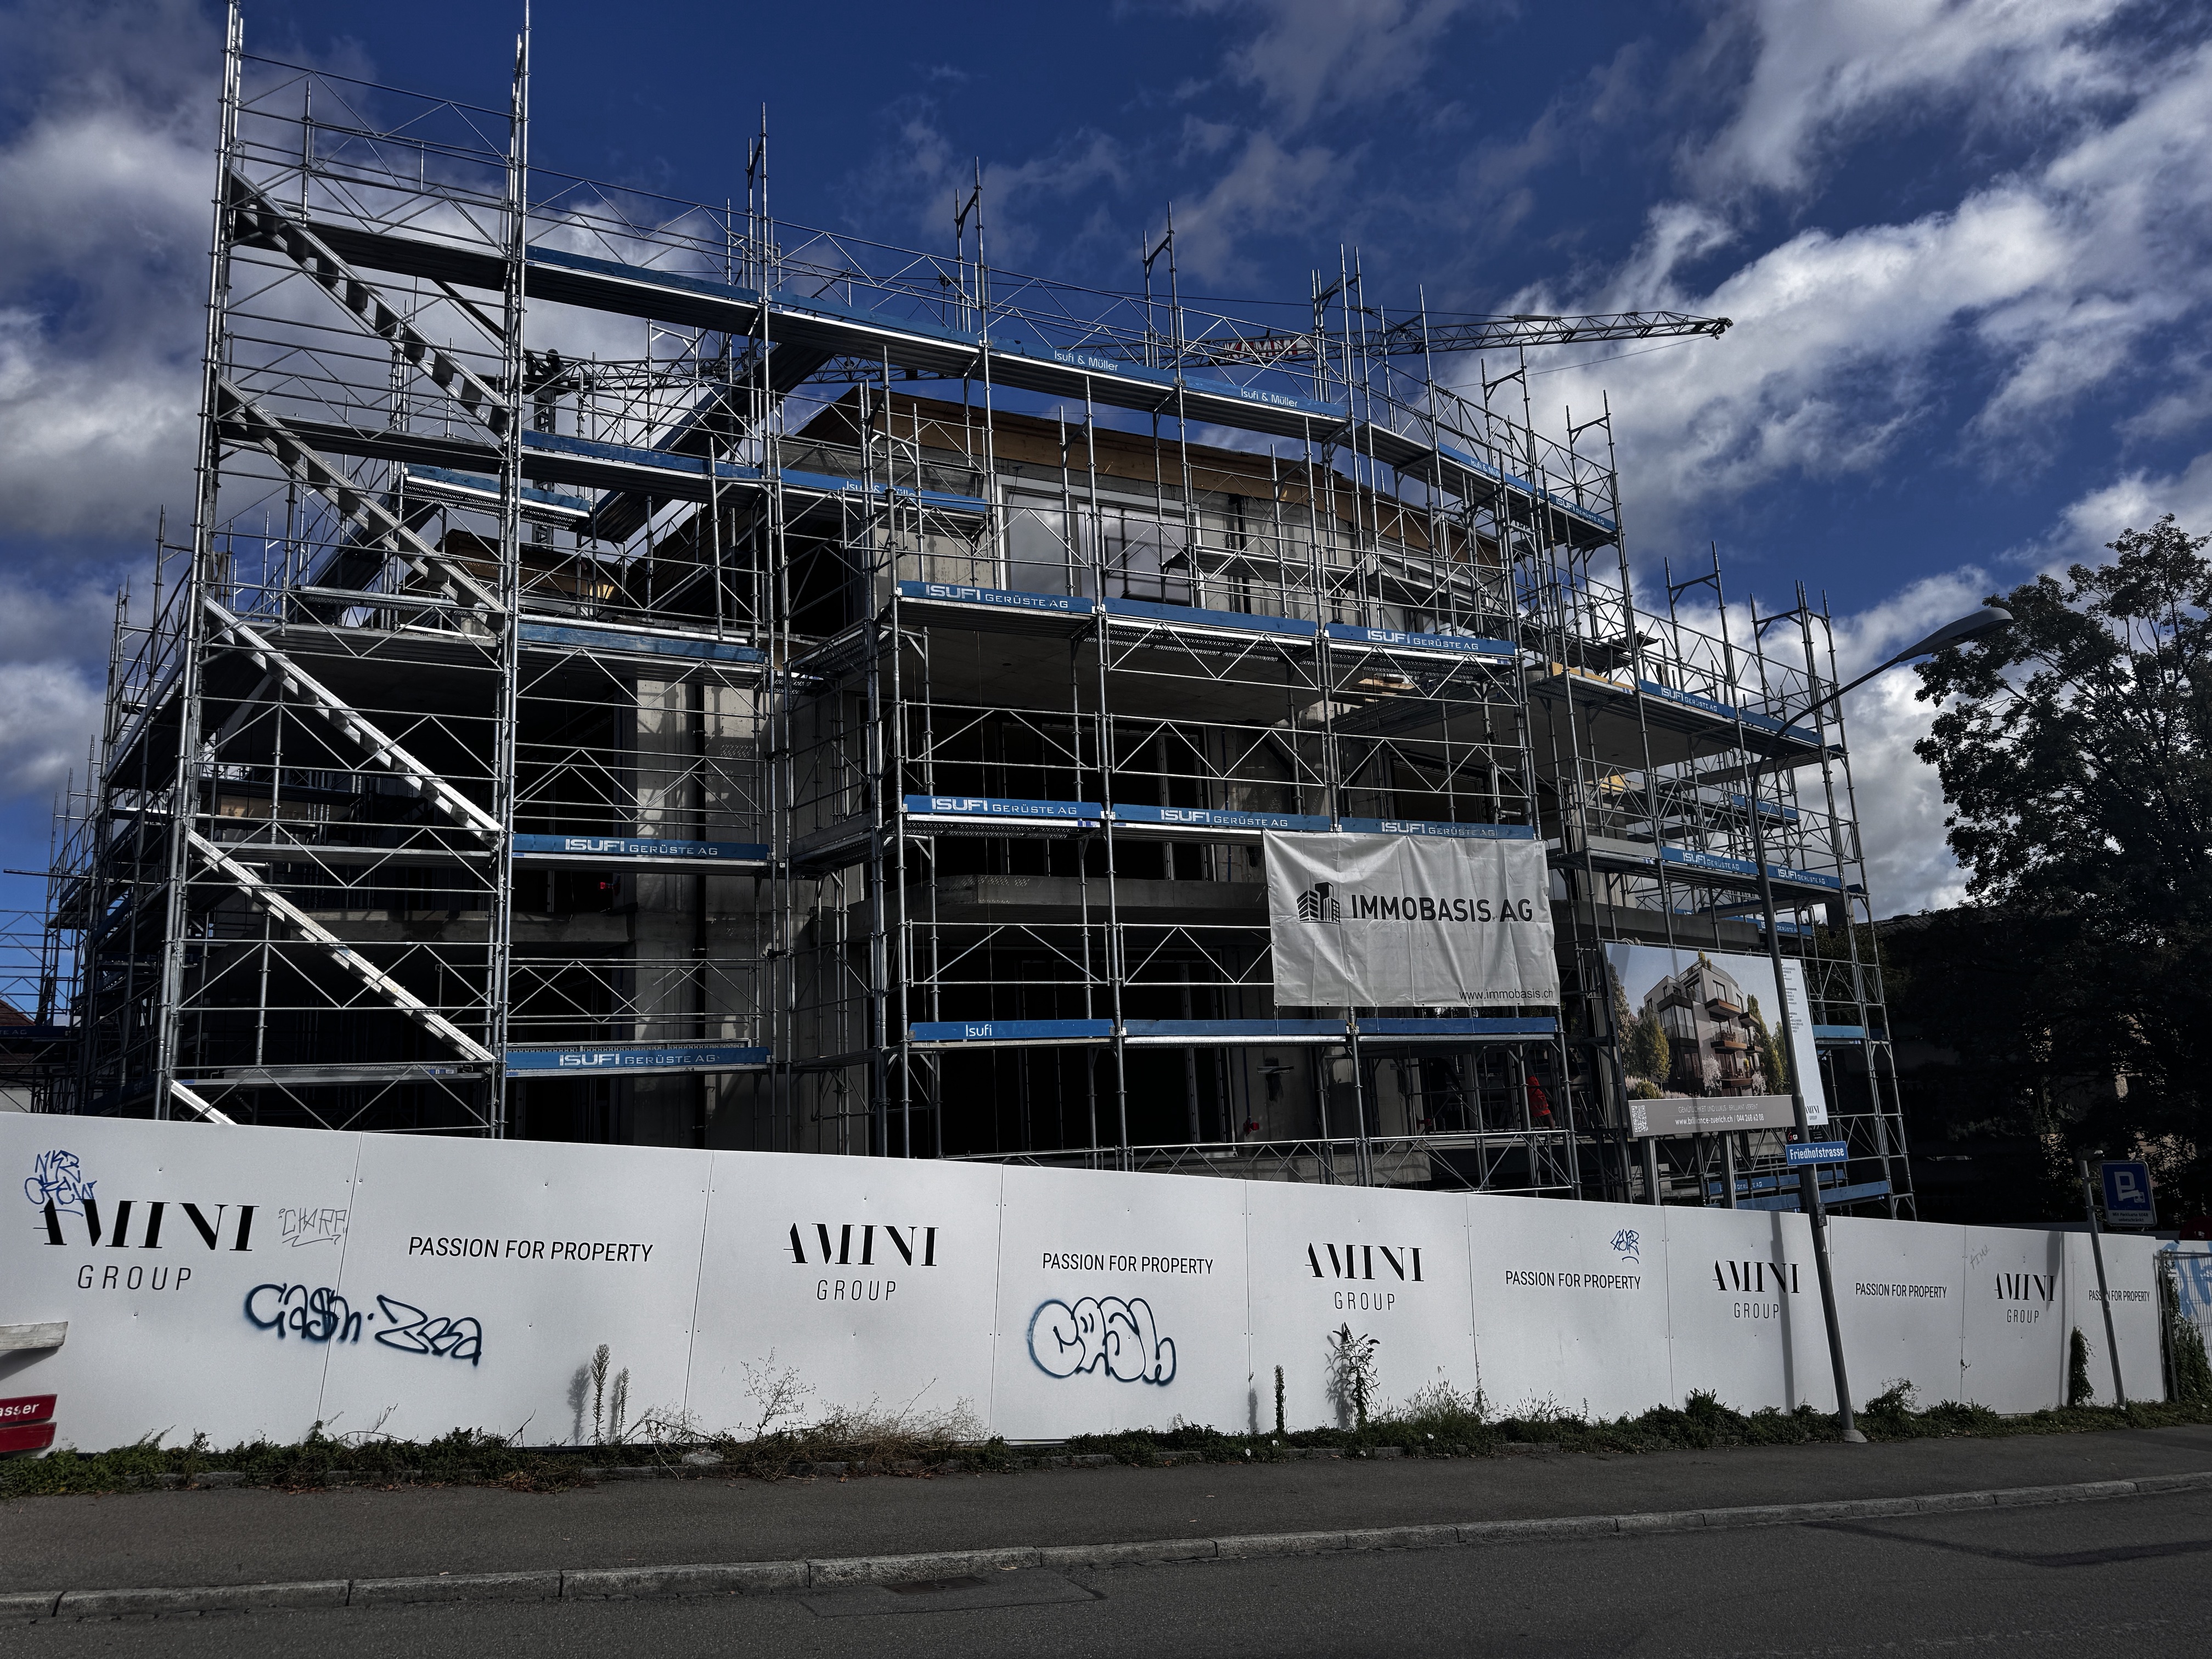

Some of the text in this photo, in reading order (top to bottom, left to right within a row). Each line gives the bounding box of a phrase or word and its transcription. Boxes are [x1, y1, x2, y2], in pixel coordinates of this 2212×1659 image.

[1054, 350, 1118, 371] Isufi & Müller
[1241, 387, 1298, 407] Isufi & Müller
[1470, 458, 1482, 469] Isufi
[1489, 466, 1501, 478] Müll
[1556, 497, 1575, 511] ISUFI
[1576, 508, 1596, 521] GERÜSTE
[925, 584, 1068, 608] ISUFI GERÜSTE AG
[1367, 629, 1410, 644] ISUFI
[1414, 638, 1461, 649] GERÜSTE
[1661, 687, 1684, 701] ISUFI
[1685, 696, 1709, 709] GERÜSTE
[932, 798, 988, 811] ISUFI
[992, 804, 1054, 814] GERÜSTE
[1161, 809, 1210, 823] ISUFI
[1214, 816, 1268, 826] GERÜSTE
[1381, 822, 1425, 834] ISUFI
[1428, 827, 1478, 835] GERÜSTE
[565, 839, 624, 852] ISUFI
[629, 844, 694, 855] GERÜSTE
[1682, 852, 1706, 865] ISUFI
[1707, 859, 1731, 869] GERÜSTE
[1778, 868, 1797, 879] ISUFI
[1798, 873, 1818, 883] GERÜSTE
[1351, 894, 1533, 923] IMMOBASIS AG
[1459, 988, 1553, 1000] www.immobasis.ch
[965, 1024, 993, 1037] Isufi
[559, 1054, 715, 1066] ISUFI GERÜSTE AG
[1789, 1147, 1844, 1160] Friedhofstrasse
[33, 1199, 260, 1252] AMINI
[409, 1236, 653, 1262] PASSION FOR PROPERTY
[783, 1223, 939, 1267] AMINI
[1043, 1252, 1213, 1274] PASSION FOR PROPERTY
[1305, 1242, 1425, 1282] AMINI
[78, 1265, 192, 1291] GROUP
[1506, 1270, 1641, 1290] PASSION FOR PROPERTY
[1712, 1260, 1800, 1294] AMINI
[1994, 1273, 2055, 1301] AMINI
[817, 1279, 897, 1301] GROUP
[1855, 1283, 1947, 1298] PASSION FOR PROPERTY
[2089, 1290, 2150, 1302] PASSN FOR PROPERTY
[1334, 1291, 1395, 1311] GROUP
[1734, 1302, 1780, 1319] GROUP
[2007, 1309, 2039, 1323] GROUP
